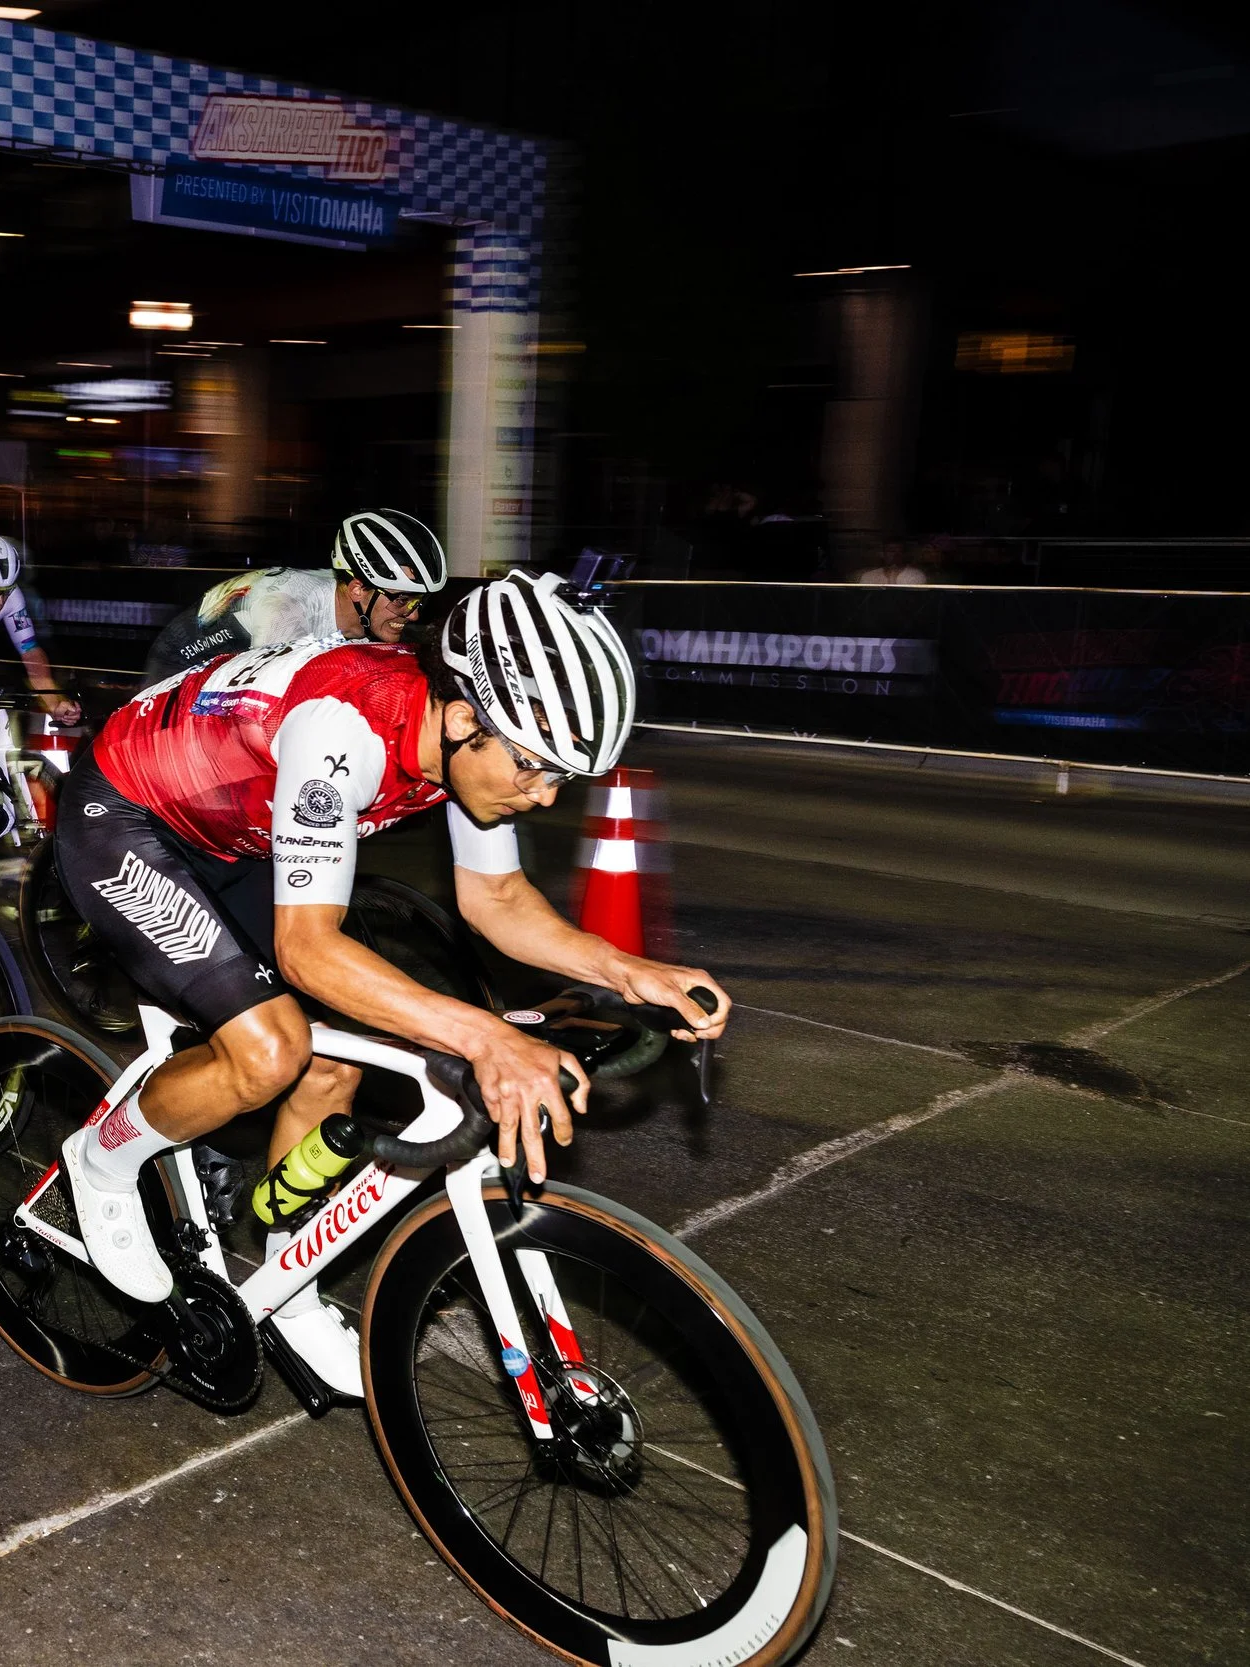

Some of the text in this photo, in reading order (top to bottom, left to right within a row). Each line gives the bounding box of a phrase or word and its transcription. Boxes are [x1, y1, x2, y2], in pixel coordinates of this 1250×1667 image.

[198, 103, 342, 156] AKSARBEN
[175, 173, 384, 237] PRESENTED BY VISITOMAHA
[354, 552, 375, 580] LAZER
[180, 639, 205, 660] GEMS
[208, 628, 234, 649] NOTE
[640, 628, 900, 674] OMAHASPORTS
[466, 632, 495, 712] FOUNDATION
[498, 645, 524, 705] LAZER
[643, 664, 892, 697] COMMISSION
[300, 781, 321, 799] CENTURY
[275, 835, 344, 849] PLAN2PEAK
[110, 850, 222, 960] FOUNDATION
[279, 1163, 396, 1271] Wilier
